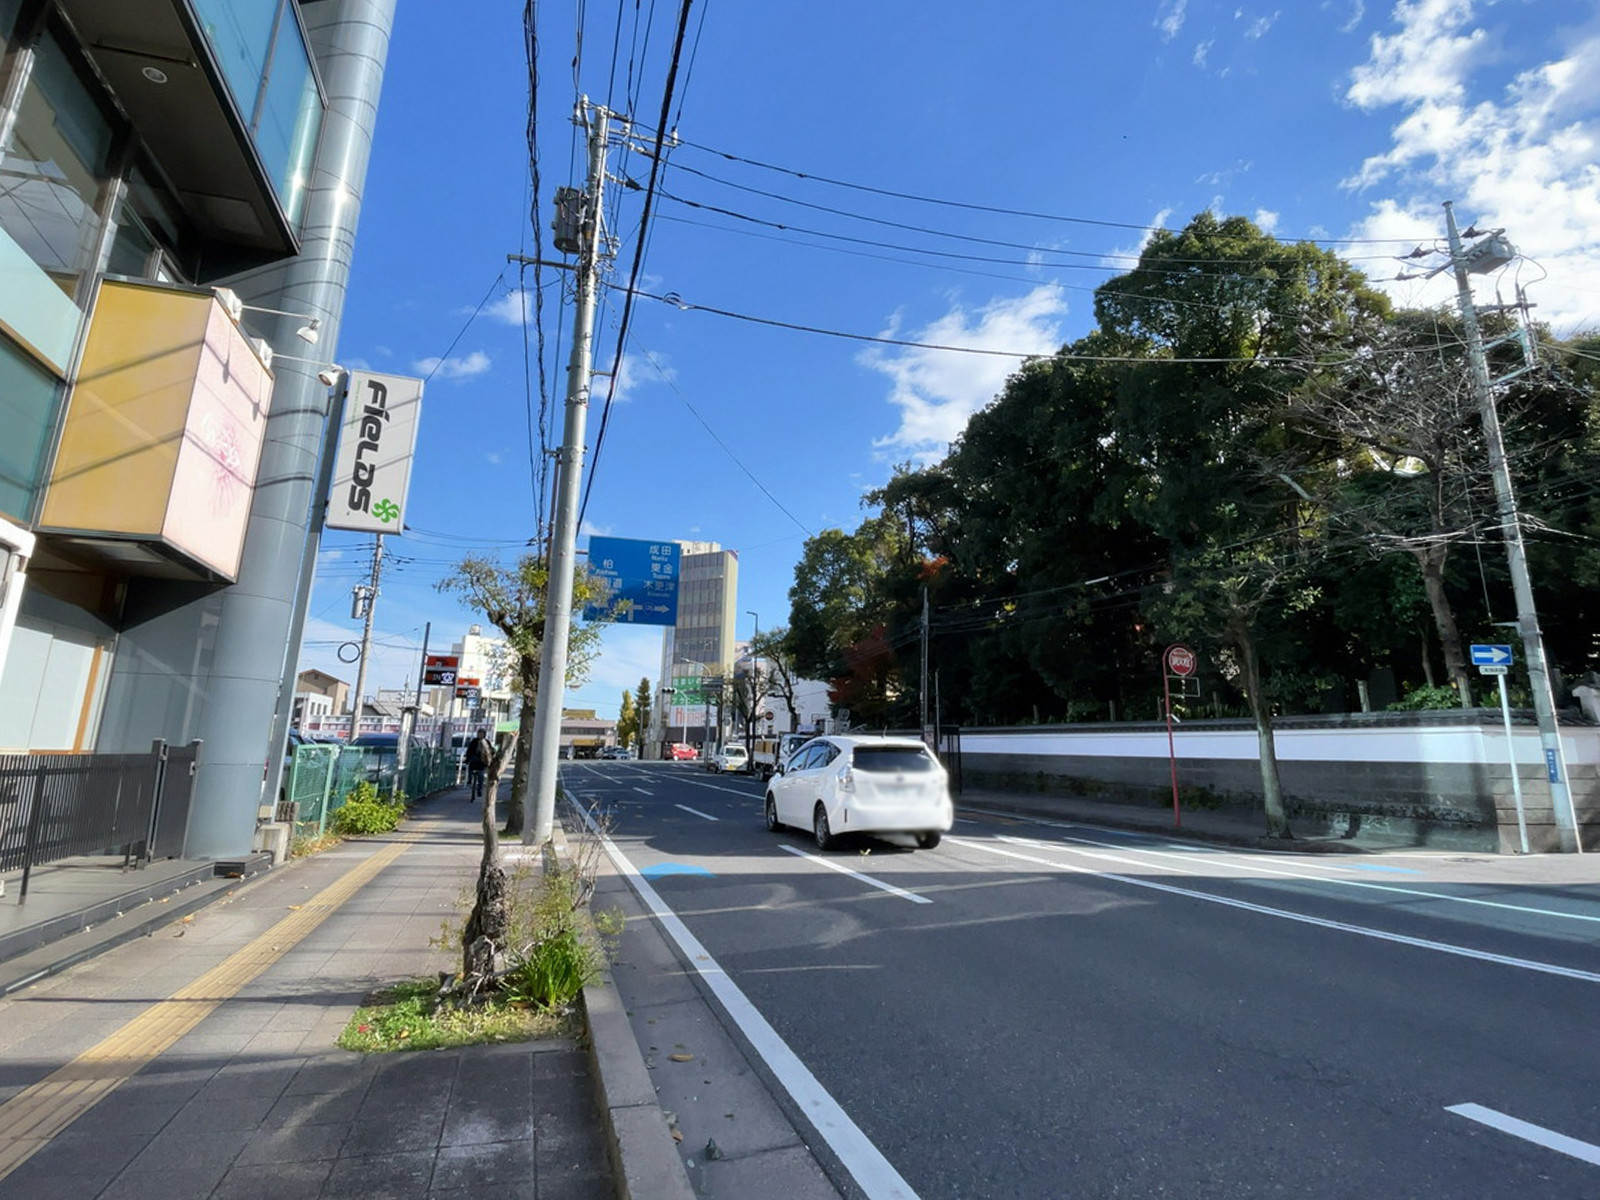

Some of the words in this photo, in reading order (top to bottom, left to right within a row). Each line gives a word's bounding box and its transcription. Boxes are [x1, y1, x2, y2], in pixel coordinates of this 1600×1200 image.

[650, 545, 672, 555] 成田
[603, 559, 614, 569] 柏
[651, 563, 673, 574] 東金
